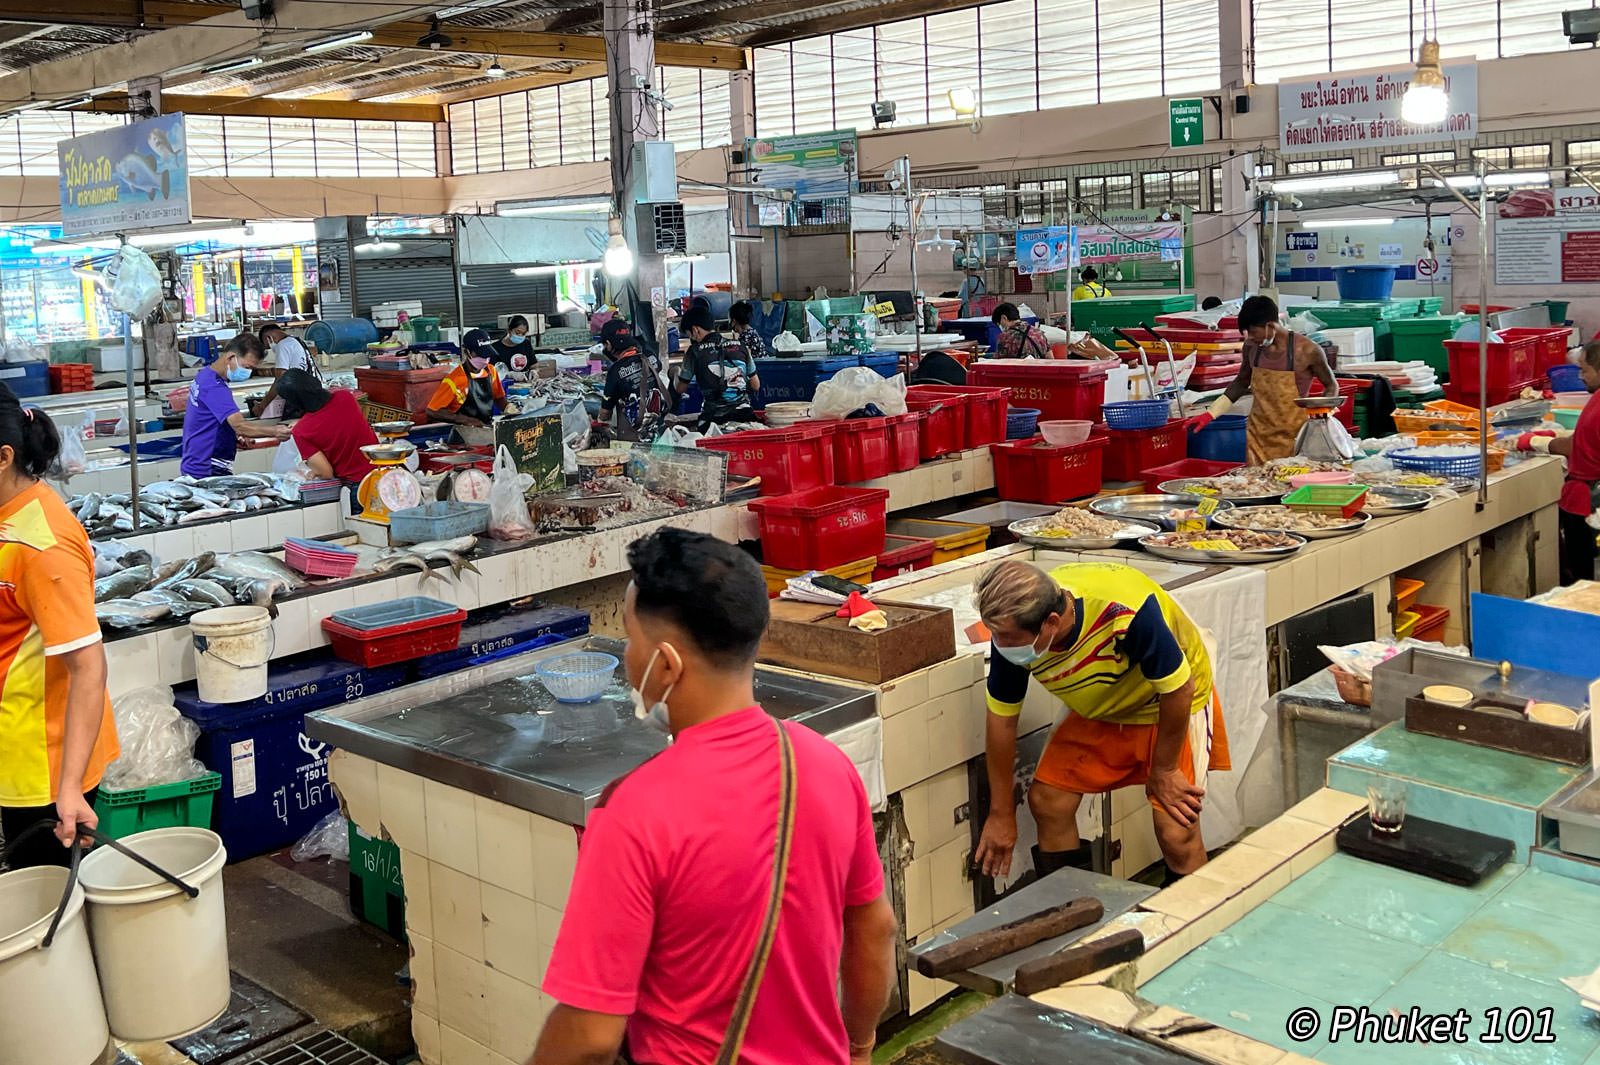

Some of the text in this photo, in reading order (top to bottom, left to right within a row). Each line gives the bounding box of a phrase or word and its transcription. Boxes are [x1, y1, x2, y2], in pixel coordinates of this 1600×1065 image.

[1301, 79, 1369, 108] ขยะในมือท่าน
[1560, 195, 1600, 208] สาร
[305, 768, 320, 782] 150
